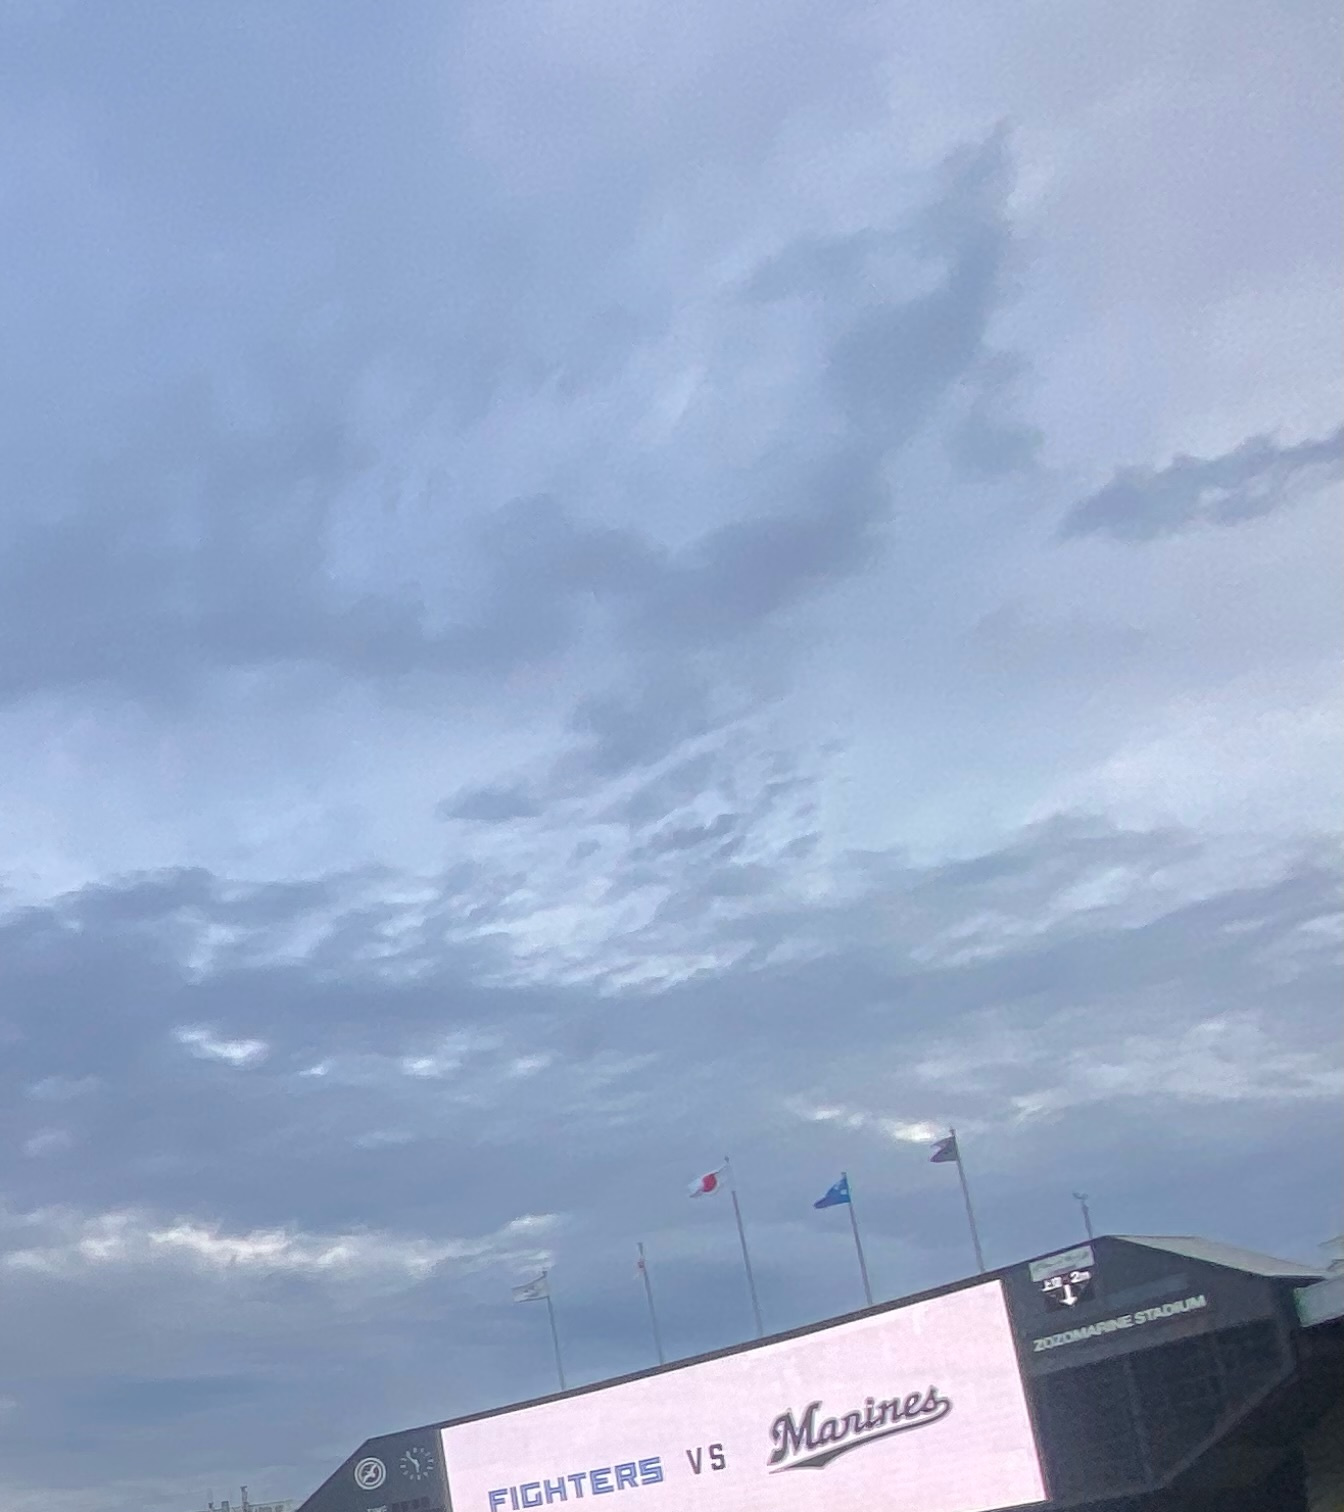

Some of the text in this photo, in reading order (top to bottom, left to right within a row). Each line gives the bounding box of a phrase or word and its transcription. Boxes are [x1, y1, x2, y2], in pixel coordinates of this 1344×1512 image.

[1032, 1295, 1208, 1353] ZOZOMARINE STADIUM
[686, 1443, 727, 1475] VS
[767, 1385, 952, 1474] Marines
